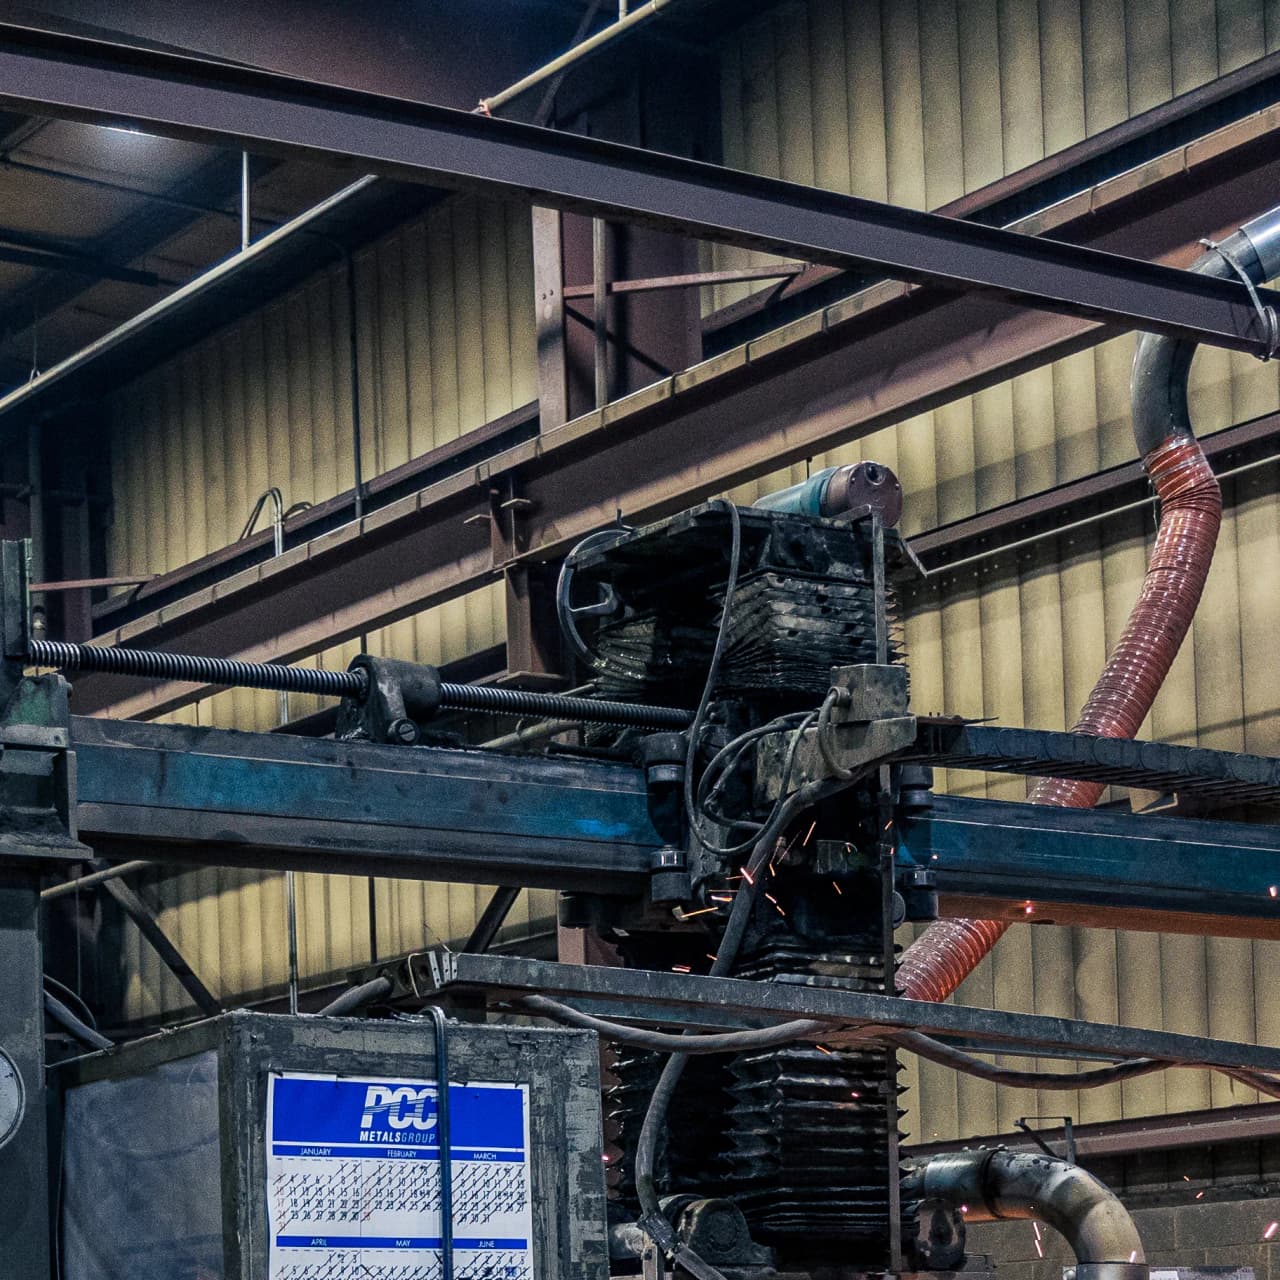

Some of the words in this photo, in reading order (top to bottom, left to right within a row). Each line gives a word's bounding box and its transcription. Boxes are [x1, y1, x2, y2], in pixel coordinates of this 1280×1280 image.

[360, 1085, 439, 1130] PCC
[301, 1148, 331, 1156] JANUARY
[387, 1149, 417, 1158] FEBRUARY
[311, 1239, 327, 1247] APRIL
